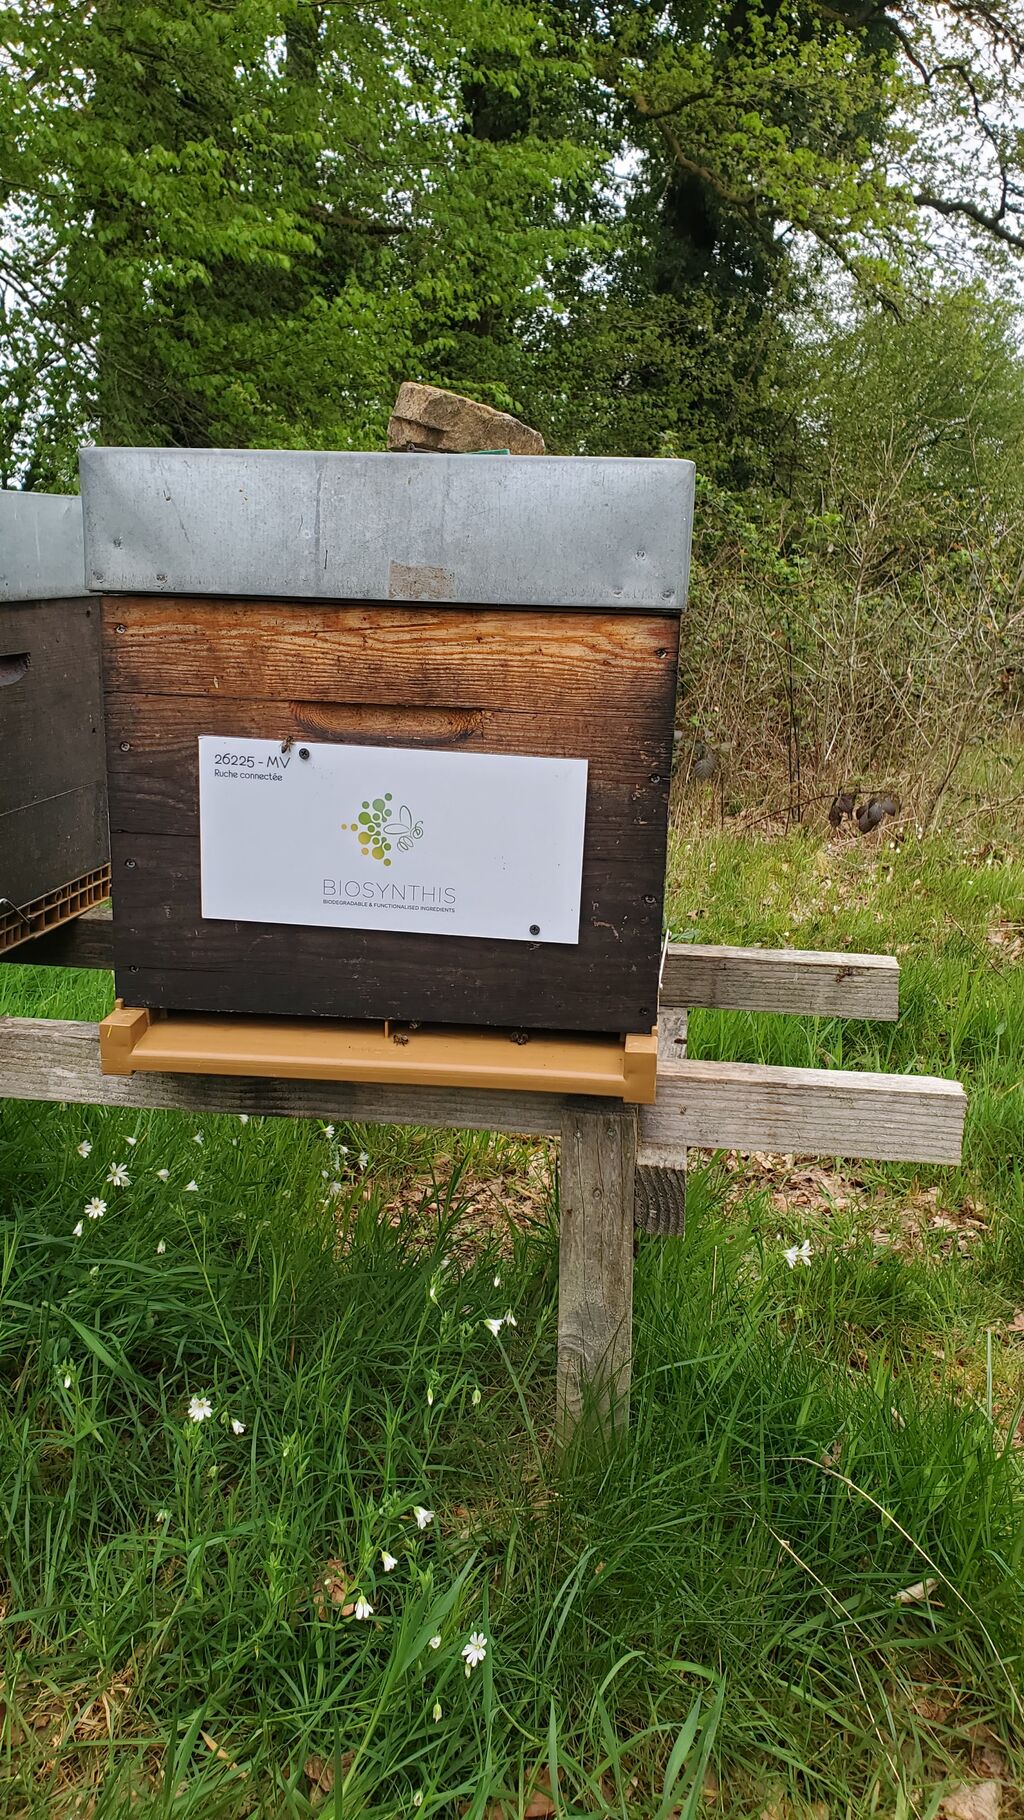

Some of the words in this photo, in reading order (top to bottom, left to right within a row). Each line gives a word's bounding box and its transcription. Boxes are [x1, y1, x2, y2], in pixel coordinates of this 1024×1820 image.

[214, 753, 255, 768] 26225
[266, 755, 291, 769] MV
[214, 768, 238, 779] Ruche
[240, 772, 283, 782] connectée
[323, 879, 456, 904] BIOSYNTHIS
[322, 899, 368, 908] BIODEGRADABLE
[374, 902, 420, 911] FUNCTIONALISED
